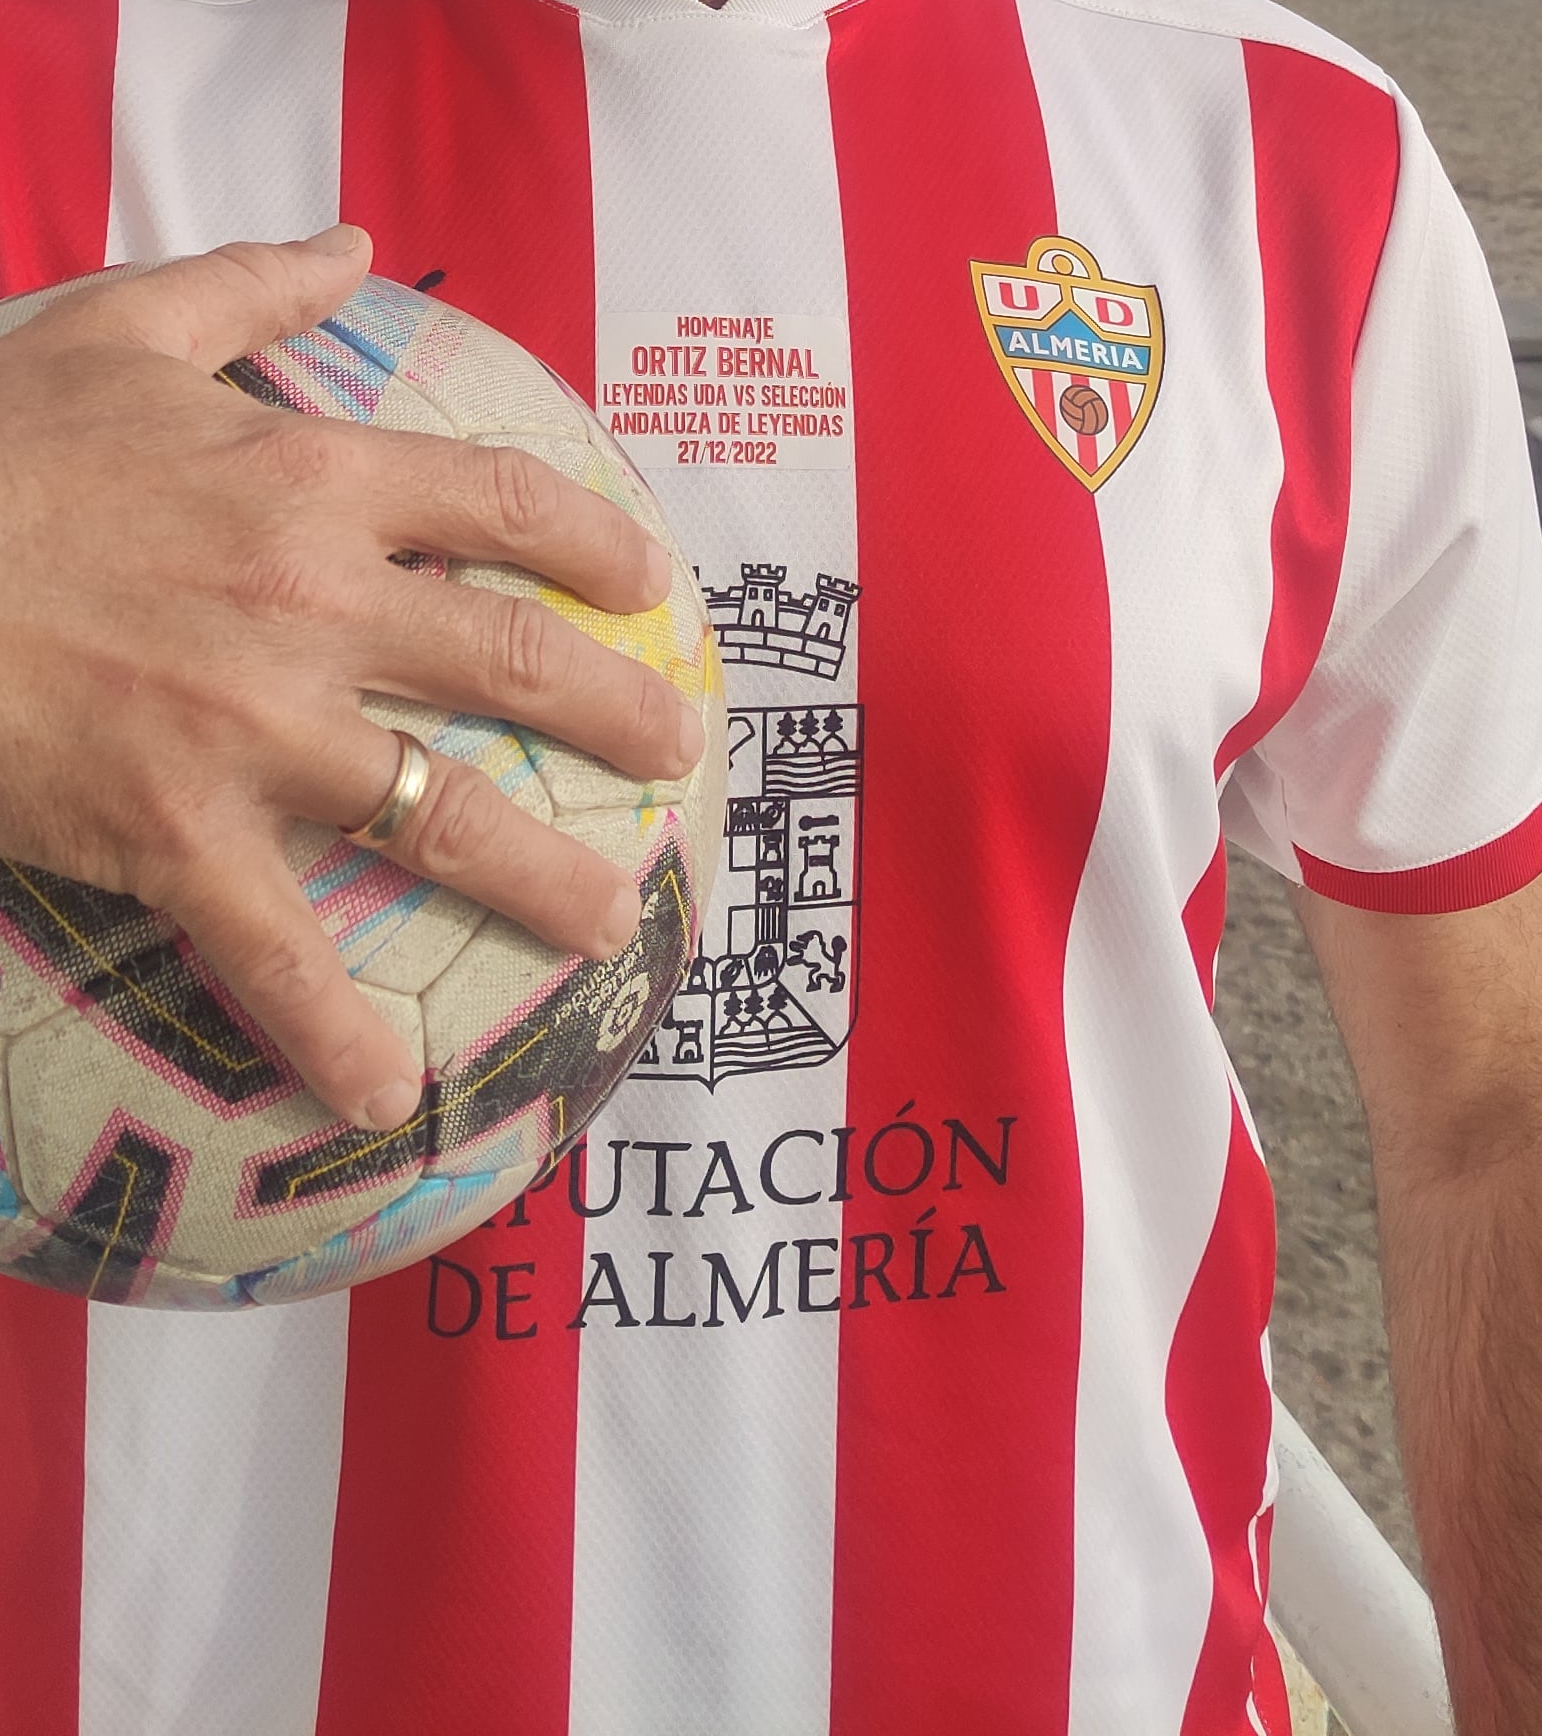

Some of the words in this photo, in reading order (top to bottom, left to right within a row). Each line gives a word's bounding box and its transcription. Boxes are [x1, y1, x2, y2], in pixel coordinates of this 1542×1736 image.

[999, 282, 1040, 311] U
[1095, 296, 1134, 326] D
[676, 316, 775, 344] HOMENAJE
[631, 346, 708, 377] ORTIZ
[716, 347, 820, 379] BERNAL
[1008, 330, 1144, 370] ALMERIA
[603, 383, 688, 406] LEYENDAS
[693, 384, 727, 406] UDA
[733, 384, 756, 407] VS
[761, 382, 847, 409] SELECCIÓN
[611, 411, 711, 435] ANDALUZA
[718, 412, 741, 435] DE
[747, 413, 844, 437] LEYENDAS
[677, 440, 777, 465] 27/12/2022
[426, 1254, 538, 1342] DE
[566, 1207, 1007, 1329] ALMERÍA
